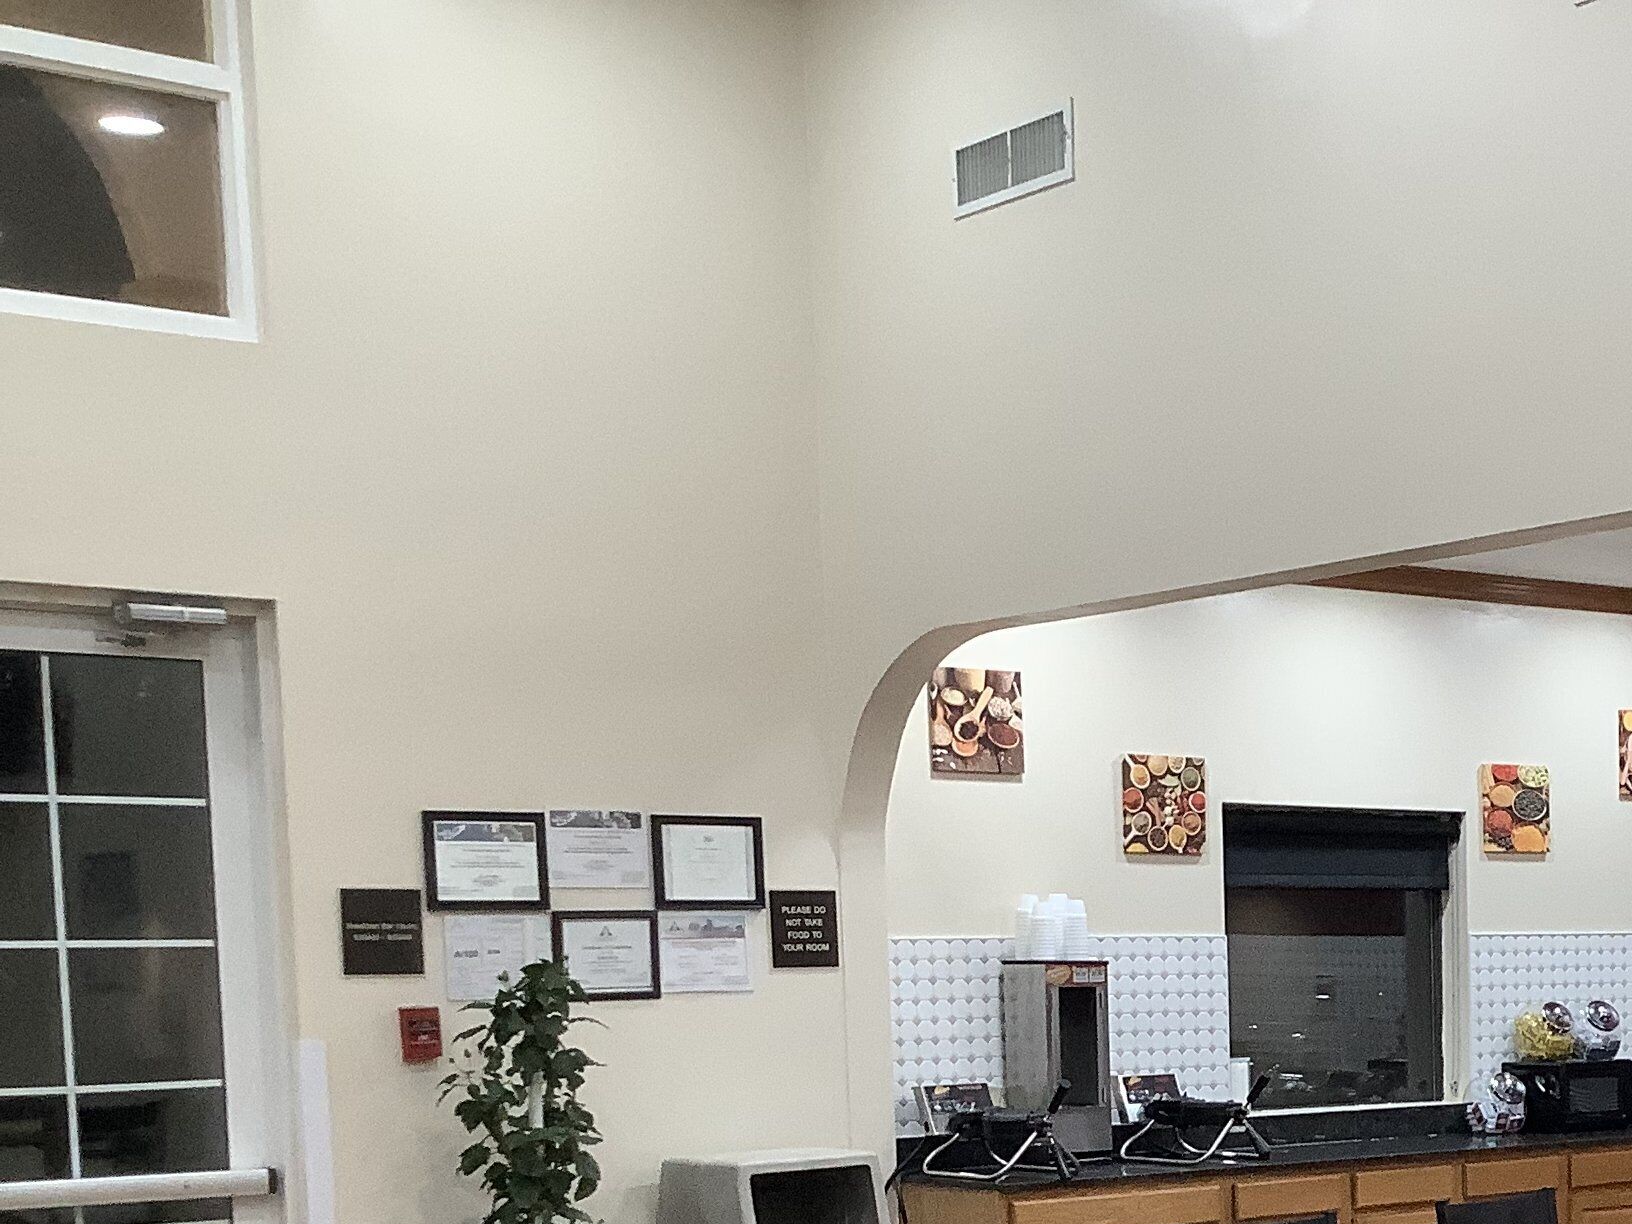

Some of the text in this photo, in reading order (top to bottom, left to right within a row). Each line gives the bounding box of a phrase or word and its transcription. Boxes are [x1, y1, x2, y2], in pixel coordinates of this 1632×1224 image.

[781, 906, 826, 914] PLEASE DO
[785, 918, 823, 926] NOT TAKE
[788, 931, 810, 939] FOOD
[781, 943, 830, 951] YOUR ROOM
